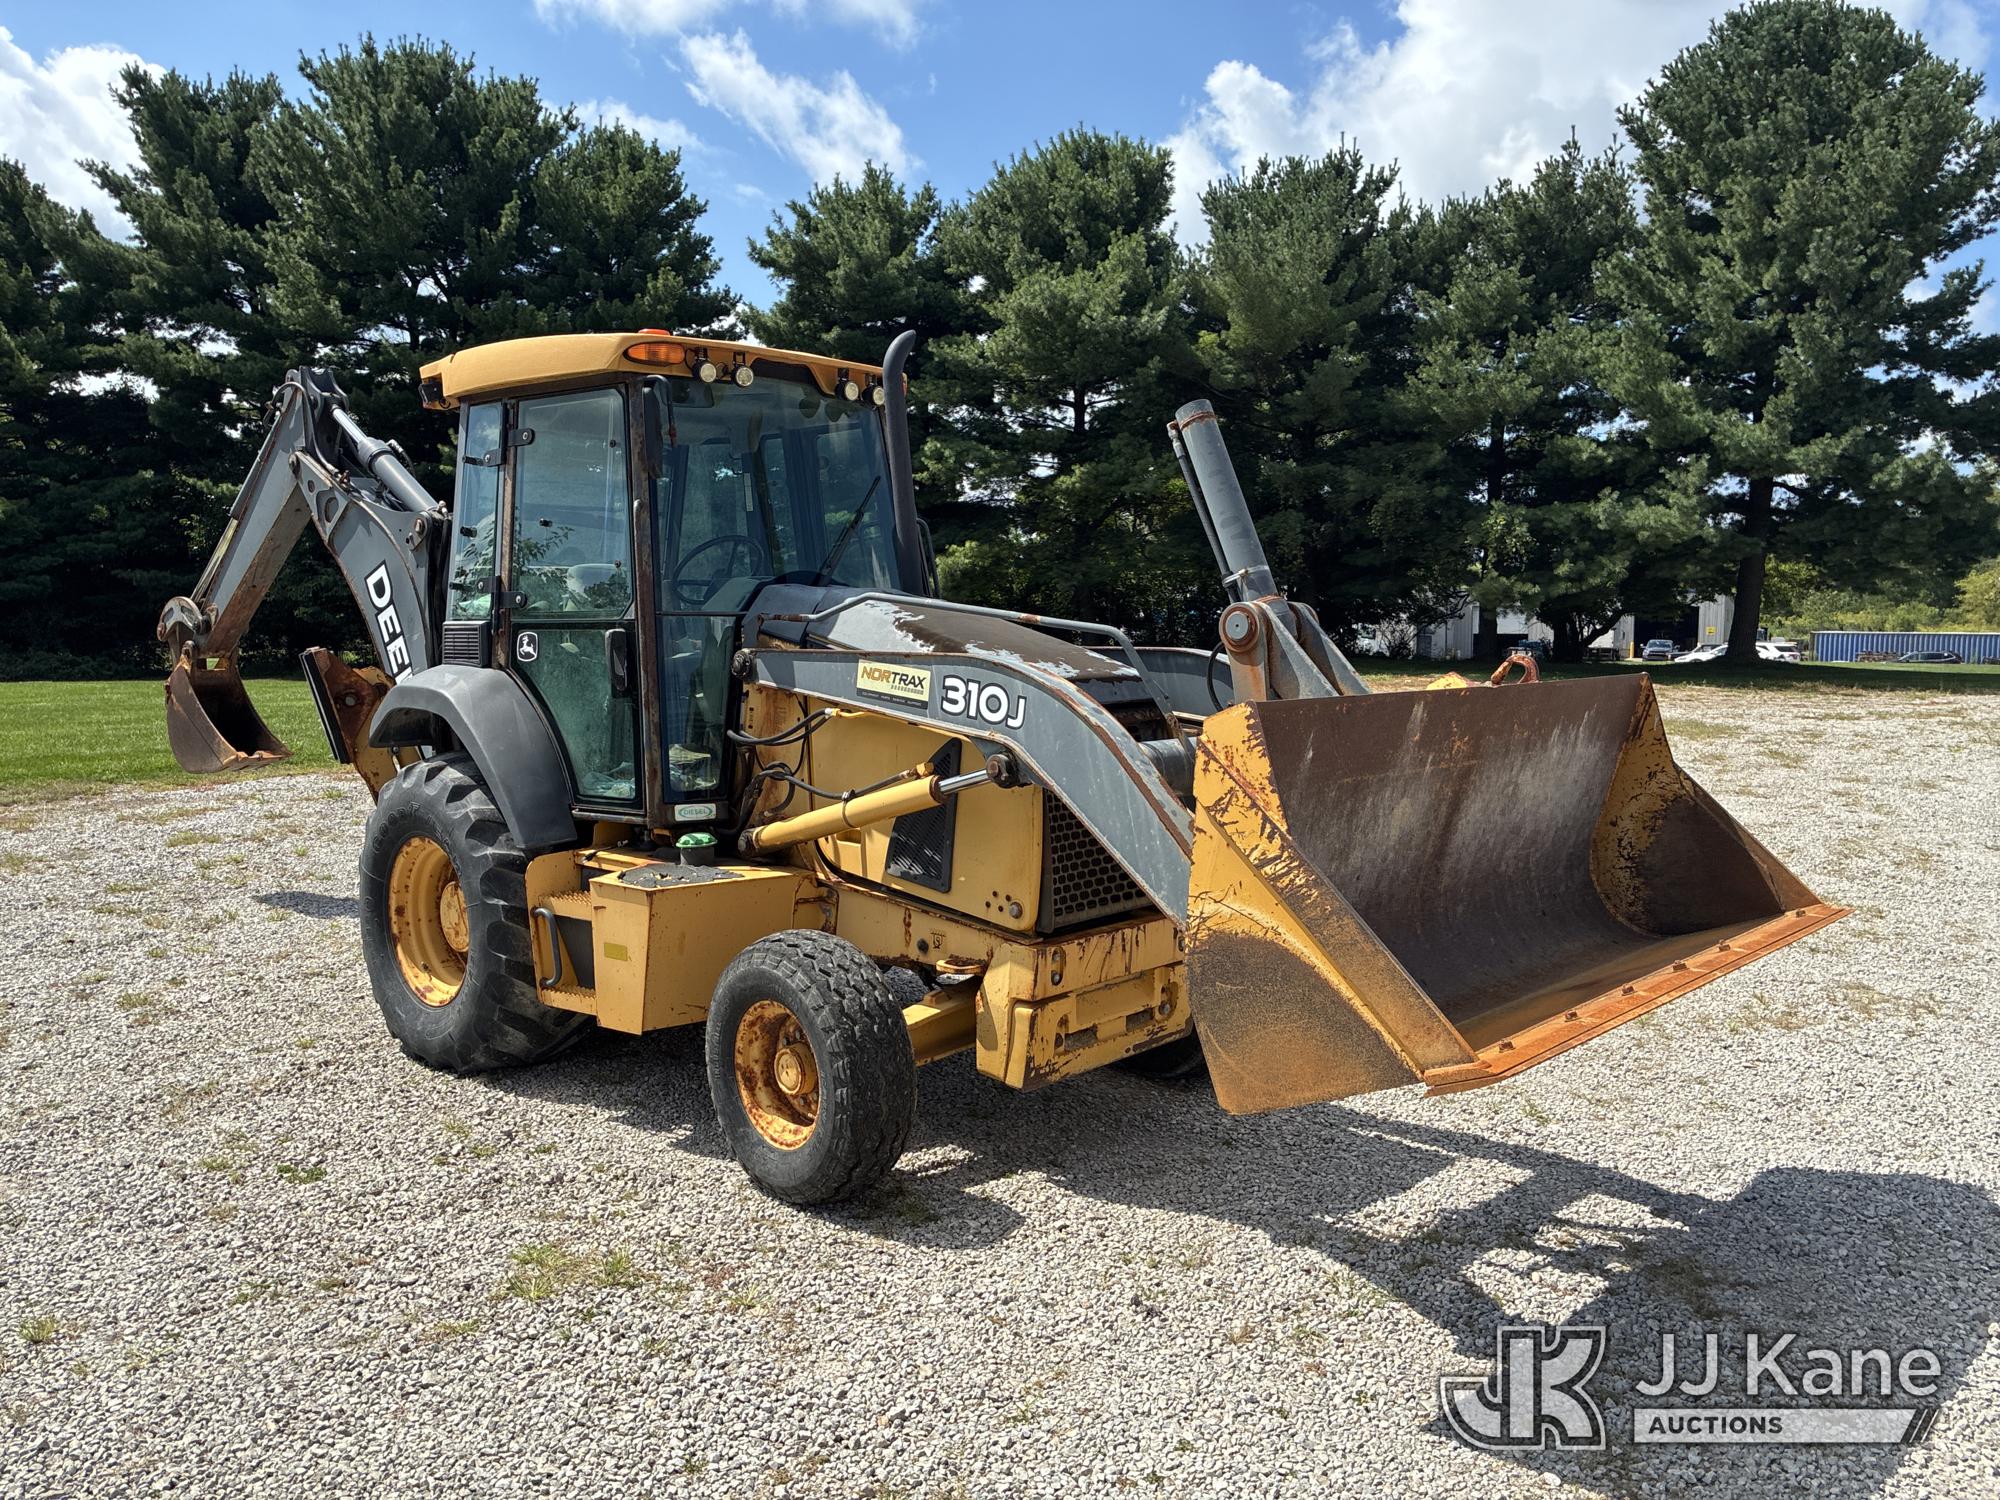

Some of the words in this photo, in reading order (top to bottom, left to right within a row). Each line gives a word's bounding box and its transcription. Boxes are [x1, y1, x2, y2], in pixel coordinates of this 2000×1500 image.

[364, 559, 414, 686] DEE
[860, 665, 927, 690] NORTRAX
[941, 674, 1027, 730] 310J
